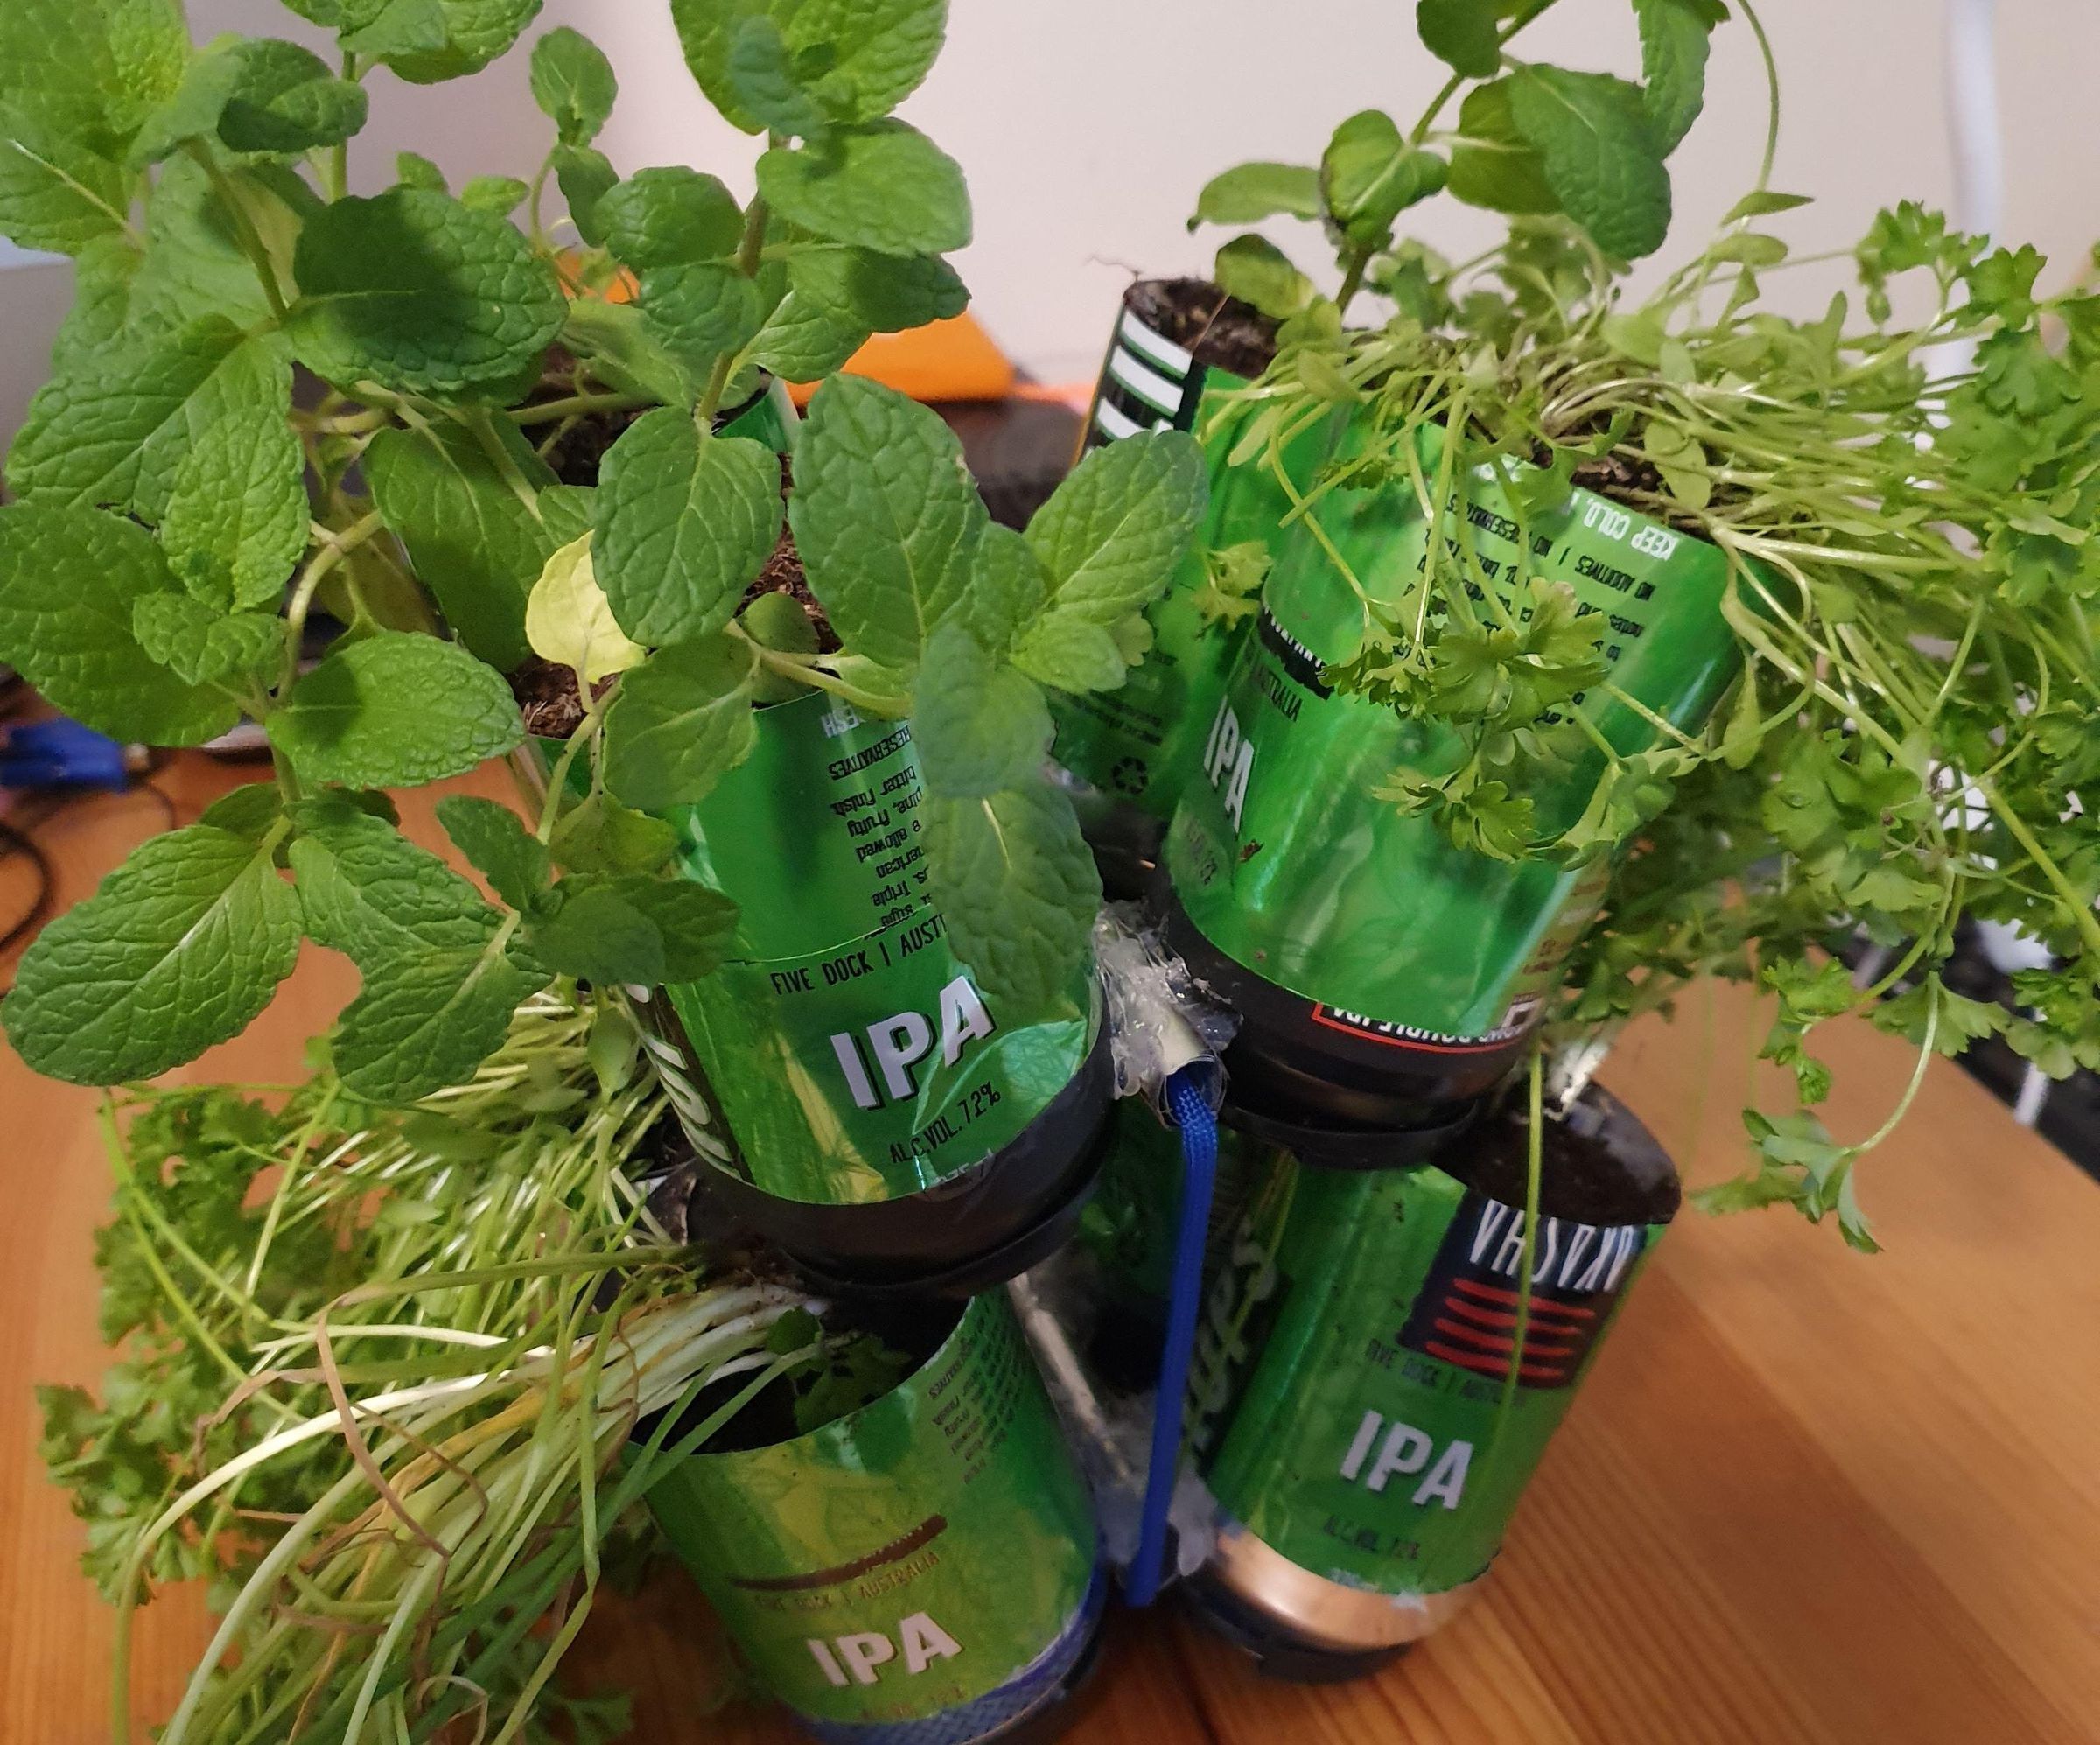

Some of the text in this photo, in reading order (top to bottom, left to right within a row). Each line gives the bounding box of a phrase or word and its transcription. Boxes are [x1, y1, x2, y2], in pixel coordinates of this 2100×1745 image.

[1631, 525, 1679, 561] KEEP
[827, 725, 912, 781] RESERVATIVES
[1203, 694, 1256, 837] IPA
[770, 966, 816, 996] FIVE
[821, 949, 875, 987] DOCK
[900, 913, 948, 957] AUST
[830, 974, 998, 1111] IPA
[1339, 1409, 1474, 1511] IPA
[805, 1610, 965, 1688] IPA
